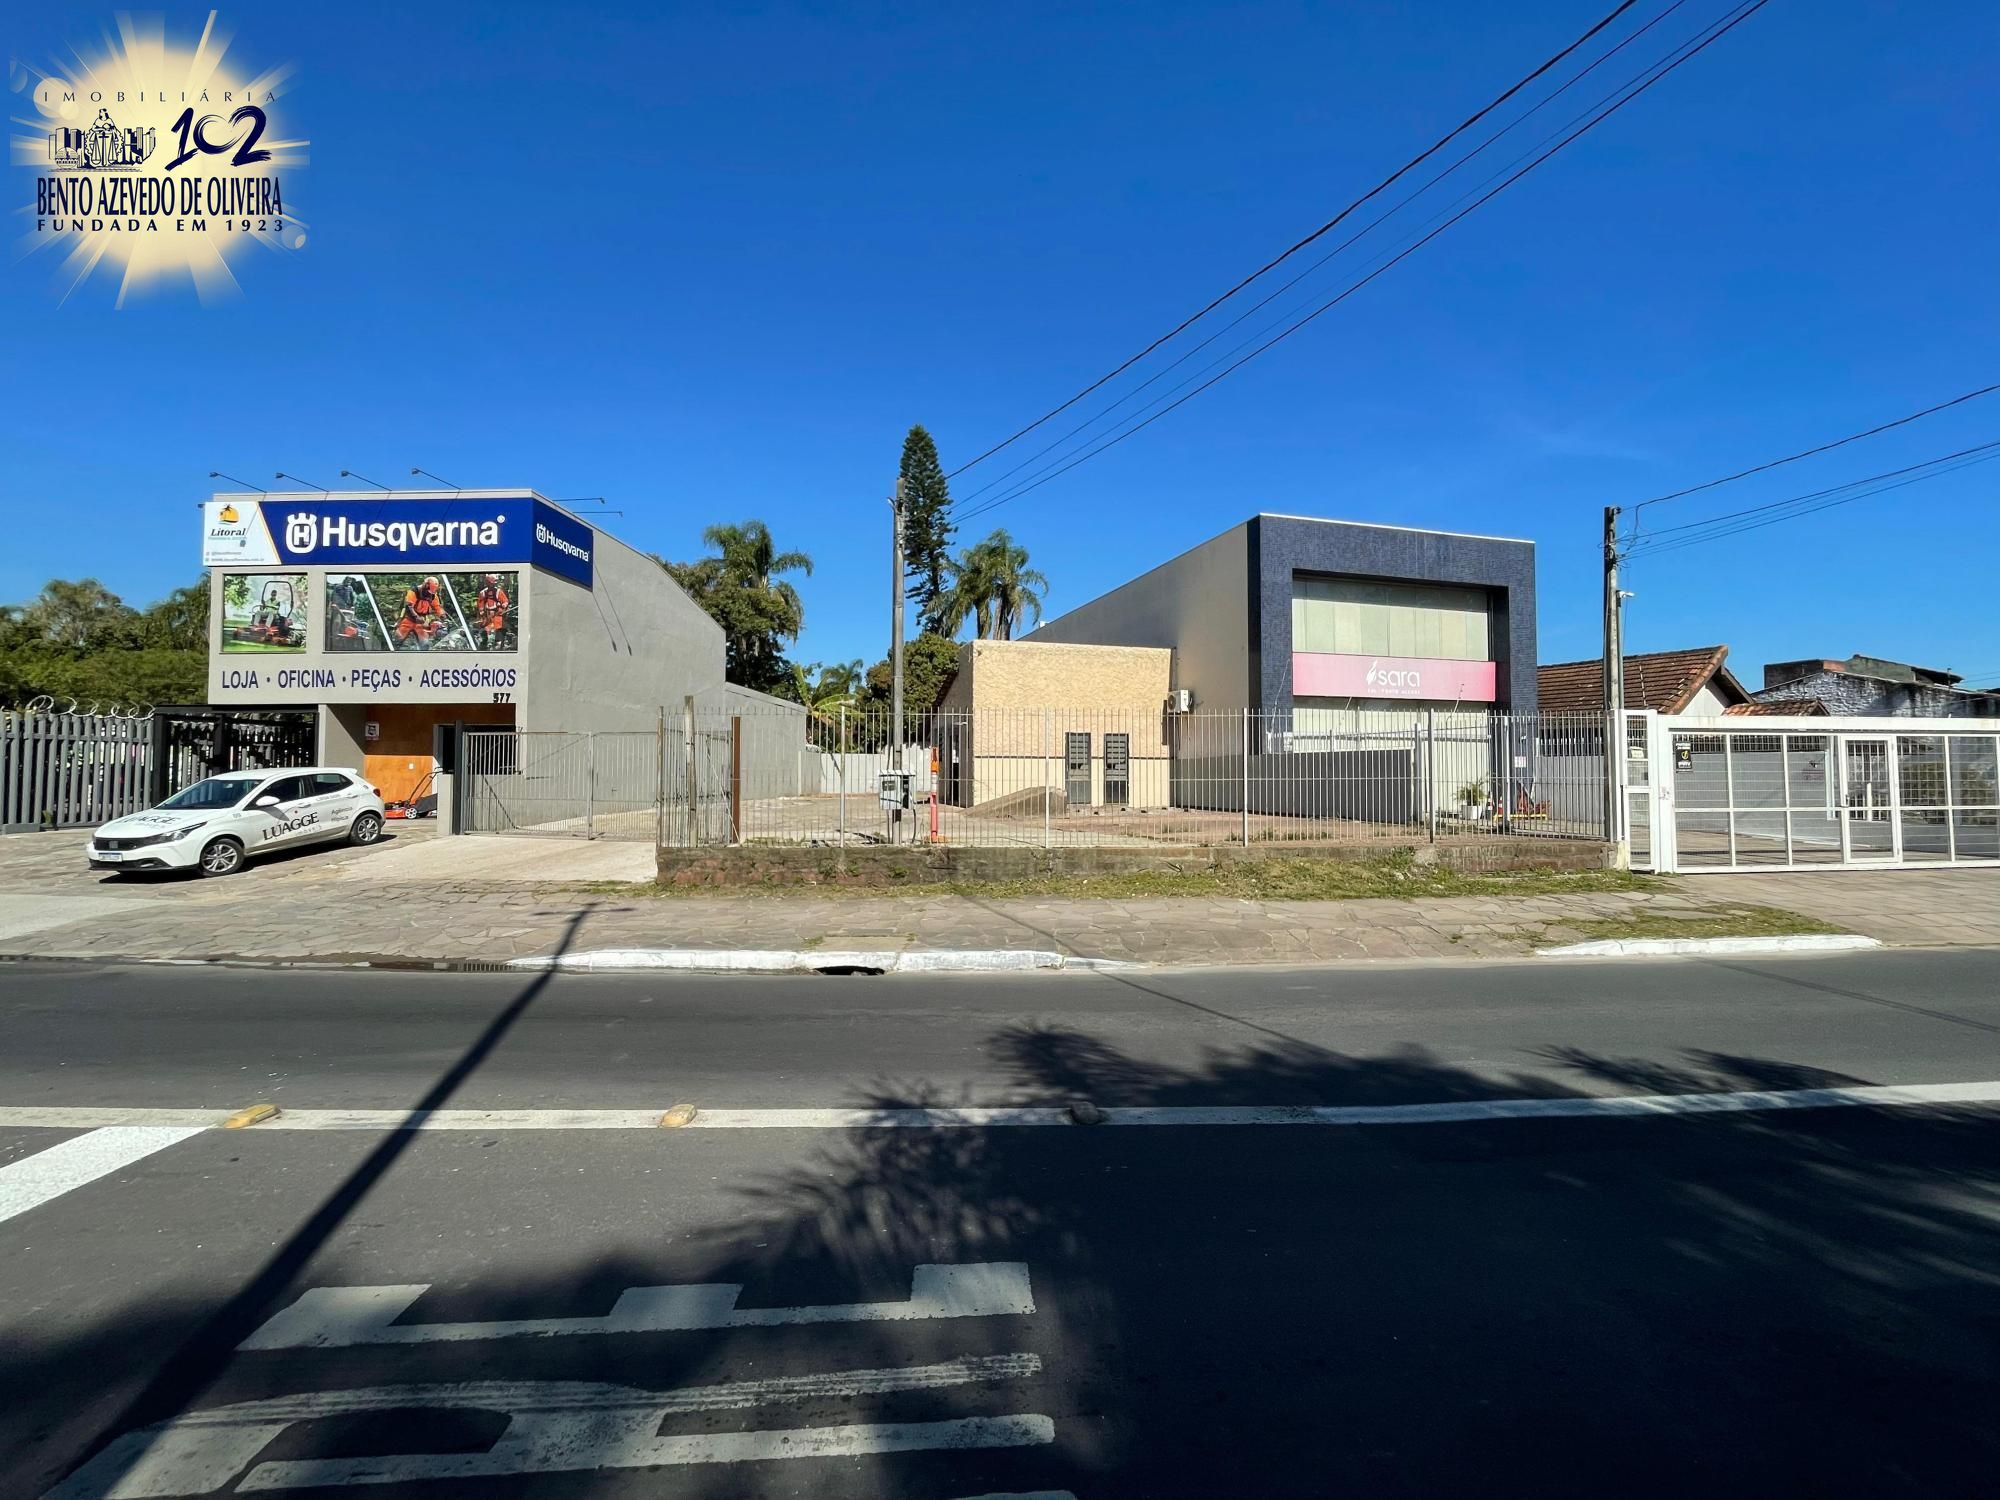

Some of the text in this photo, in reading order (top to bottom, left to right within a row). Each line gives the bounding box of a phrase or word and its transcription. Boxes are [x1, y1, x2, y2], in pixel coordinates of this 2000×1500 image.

[211, 528, 246, 537] Litoral
[322, 516, 499, 552] Husqvarna
[546, 529, 589, 562] Husqvarna
[222, 663, 516, 693] LOJA OFICINA PEÇAS ACESSÓRIOS
[1378, 670, 1420, 687] sara
[493, 692, 511, 704] 577
[262, 811, 320, 841] LUAGGE
